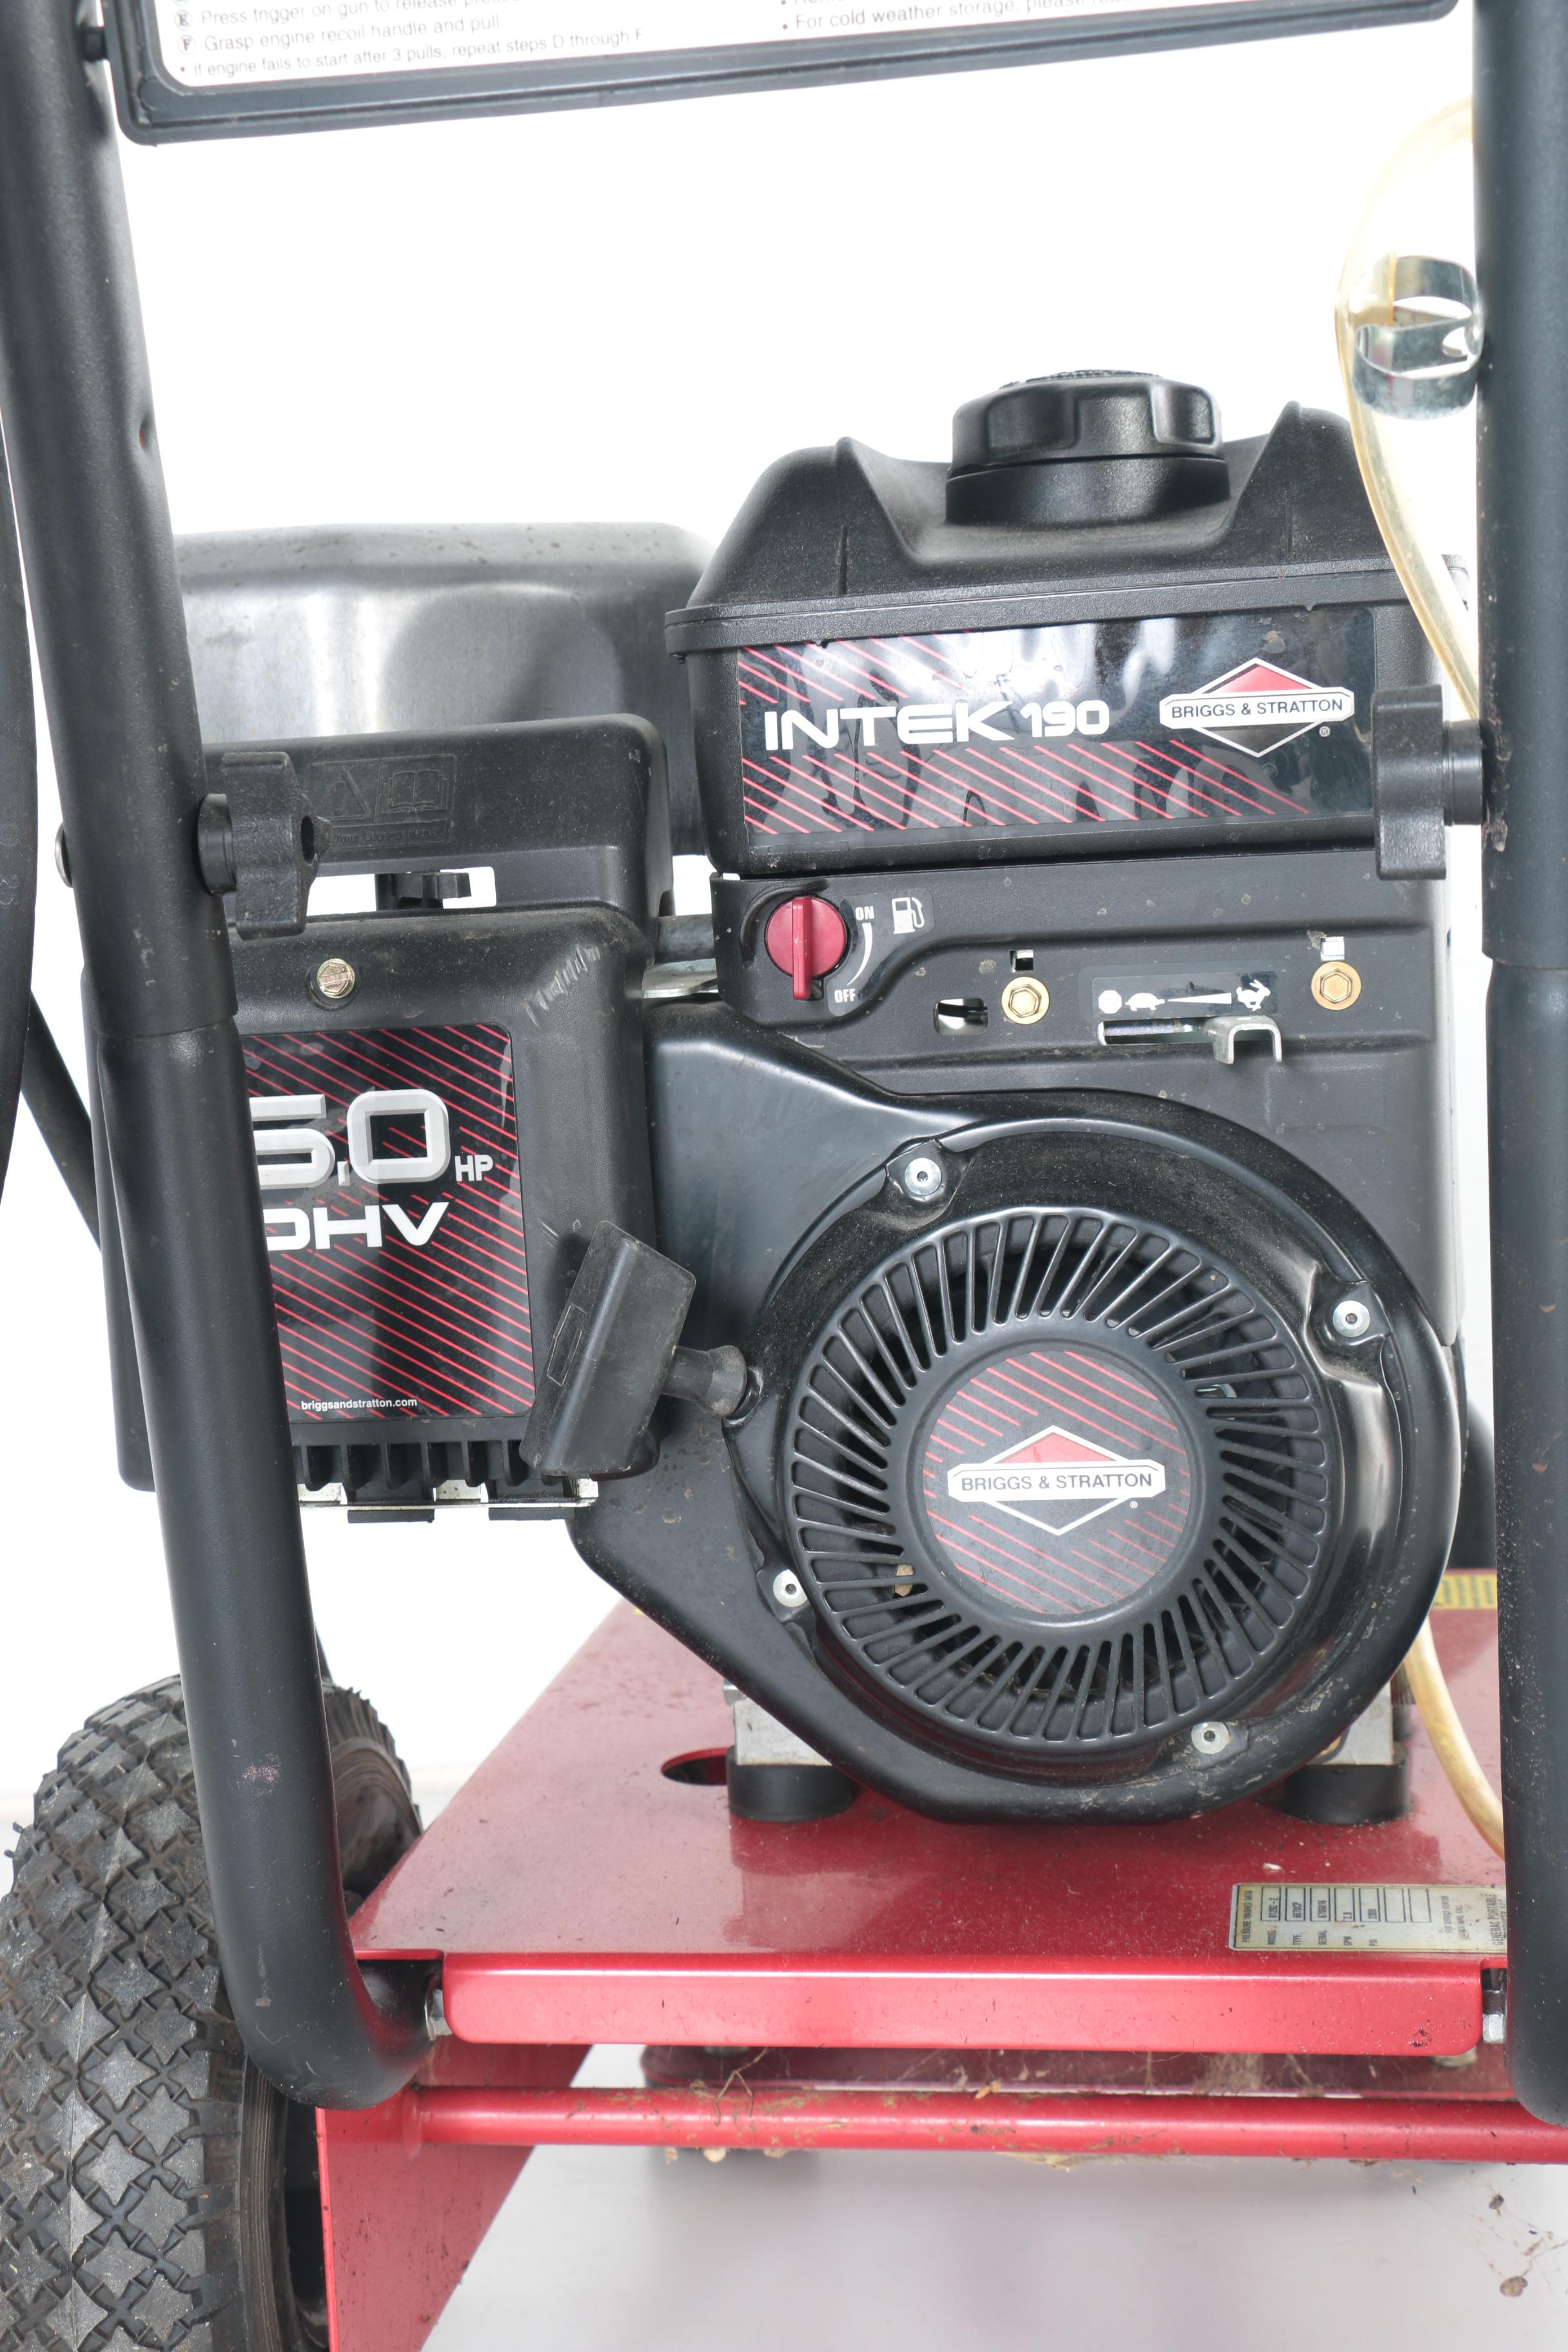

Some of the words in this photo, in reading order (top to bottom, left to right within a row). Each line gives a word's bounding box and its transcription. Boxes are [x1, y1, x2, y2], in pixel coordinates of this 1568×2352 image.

[201, 10, 248, 25] Press
[253, 6, 305, 24] trigger
[312, 5, 331, 17] on
[338, 2, 368, 19] gun
[374, 0, 389, 12] to
[796, 14, 823, 29] For
[830, 10, 865, 26] cold
[872, 5, 941, 23] weather
[204, 35, 254, 52] Grasp
[260, 32, 315, 50] engine
[322, 24, 365, 41] recoil
[371, 21, 427, 39] handle
[433, 17, 464, 34] and
[471, 14, 500, 34] pull
[208, 61, 257, 78] engine
[262, 57, 291, 72] fails
[297, 55, 310, 68] to
[316, 53, 348, 68] start
[354, 50, 386, 65] after
[392, 48, 401, 61] 3
[407, 45, 447, 63] pulls,
[453, 41, 500, 58] repeat
[507, 39, 547, 54] steps
[553, 34, 564, 49] D
[570, 30, 629, 48] through
[1171, 703, 1235, 719] BRIGGS
[1241, 702, 1251, 716] &
[1257, 699, 1342, 715] STRATTON
[765, 700, 1015, 751] INTEK
[1020, 700, 1110, 738] 190
[856, 905, 875, 921] ON
[834, 988, 856, 1003] OFF
[455, 1153, 493, 1182] HP
[301, 1398, 418, 1412] briggsandstratton.com
[961, 1475, 1032, 1492] BRIGGS
[1038, 1475, 1050, 1489] &
[1056, 1473, 1152, 1489] STRATTON
[1244, 1890, 1253, 1901] DATA
[1484, 1894, 1499, 1919] PORTABLE
[1267, 1930, 1277, 1945] MODEL
[1292, 1934, 1302, 1945] TYPE
[1318, 1930, 1327, 1945] SERIAL
[1343, 1936, 1352, 1946] GPM
[1489, 1921, 1504, 1945] GENERAC
